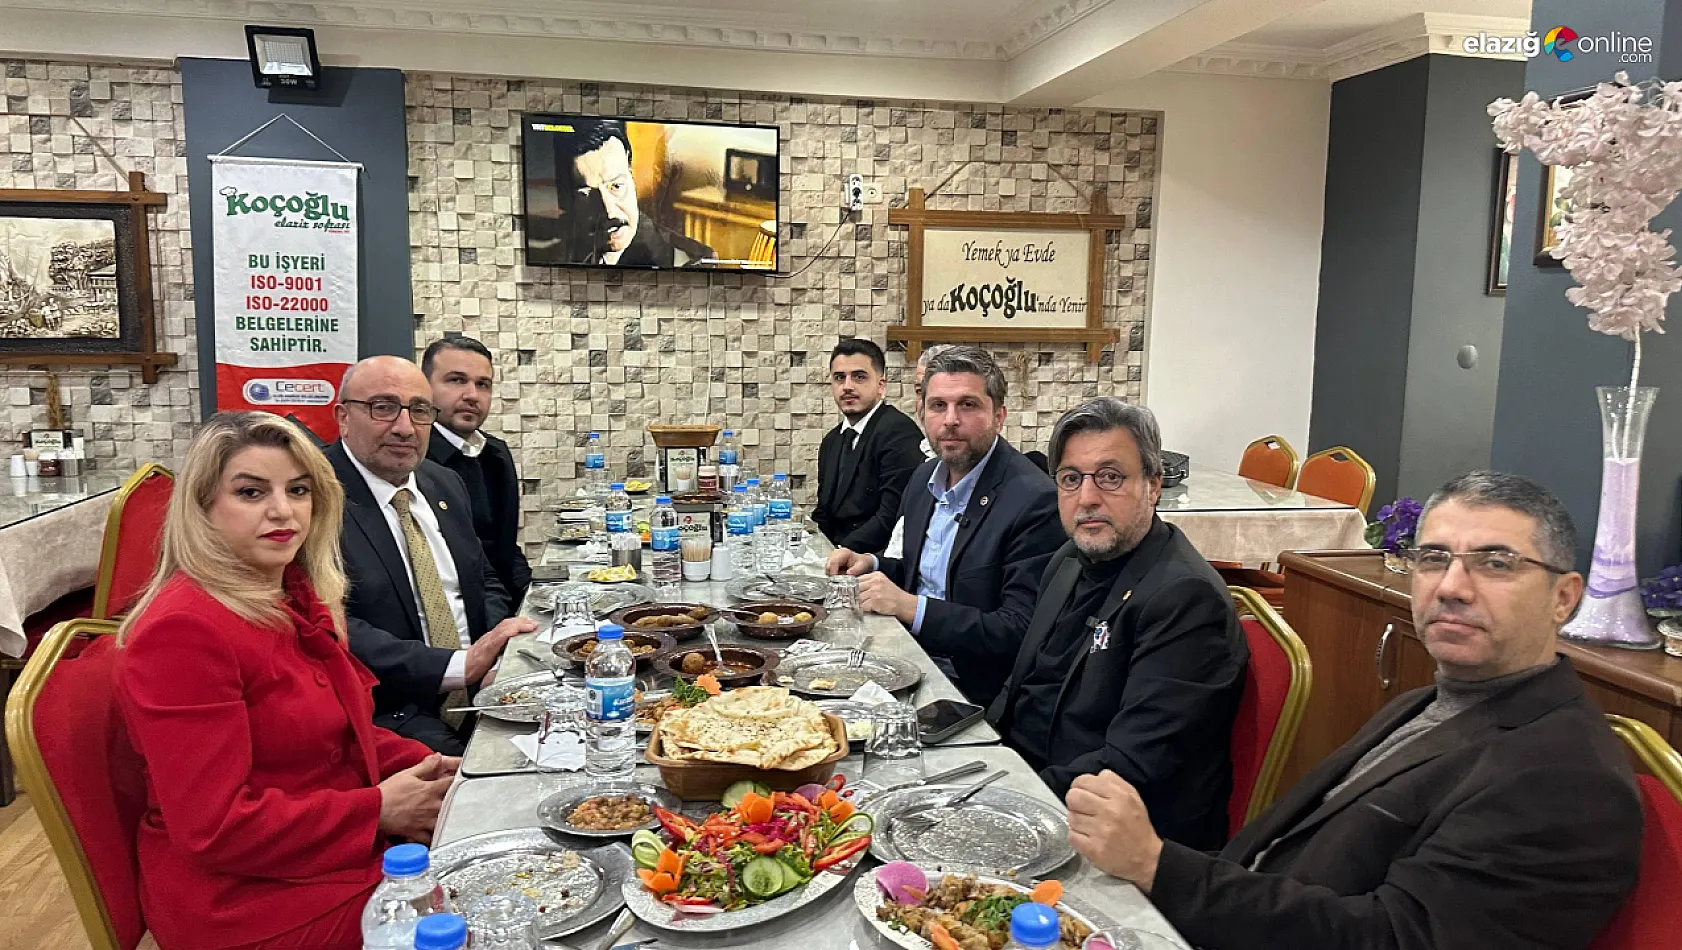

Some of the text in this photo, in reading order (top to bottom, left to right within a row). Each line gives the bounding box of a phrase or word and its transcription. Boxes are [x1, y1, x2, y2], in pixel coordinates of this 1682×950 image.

[226, 190, 350, 221] Koçoğlu
[248, 251, 326, 273] BU İŞYERİ
[961, 240, 1056, 268] Yemek ya Evde
[251, 275, 322, 292] ISO-9001
[246, 296, 328, 312] ISO-22000
[921, 298, 935, 316] ya
[937, 294, 950, 311] da
[1059, 297, 1088, 314] Yenir
[235, 315, 339, 333] BELGELERİNE
[250, 335, 327, 353] SAHİPTİR.
